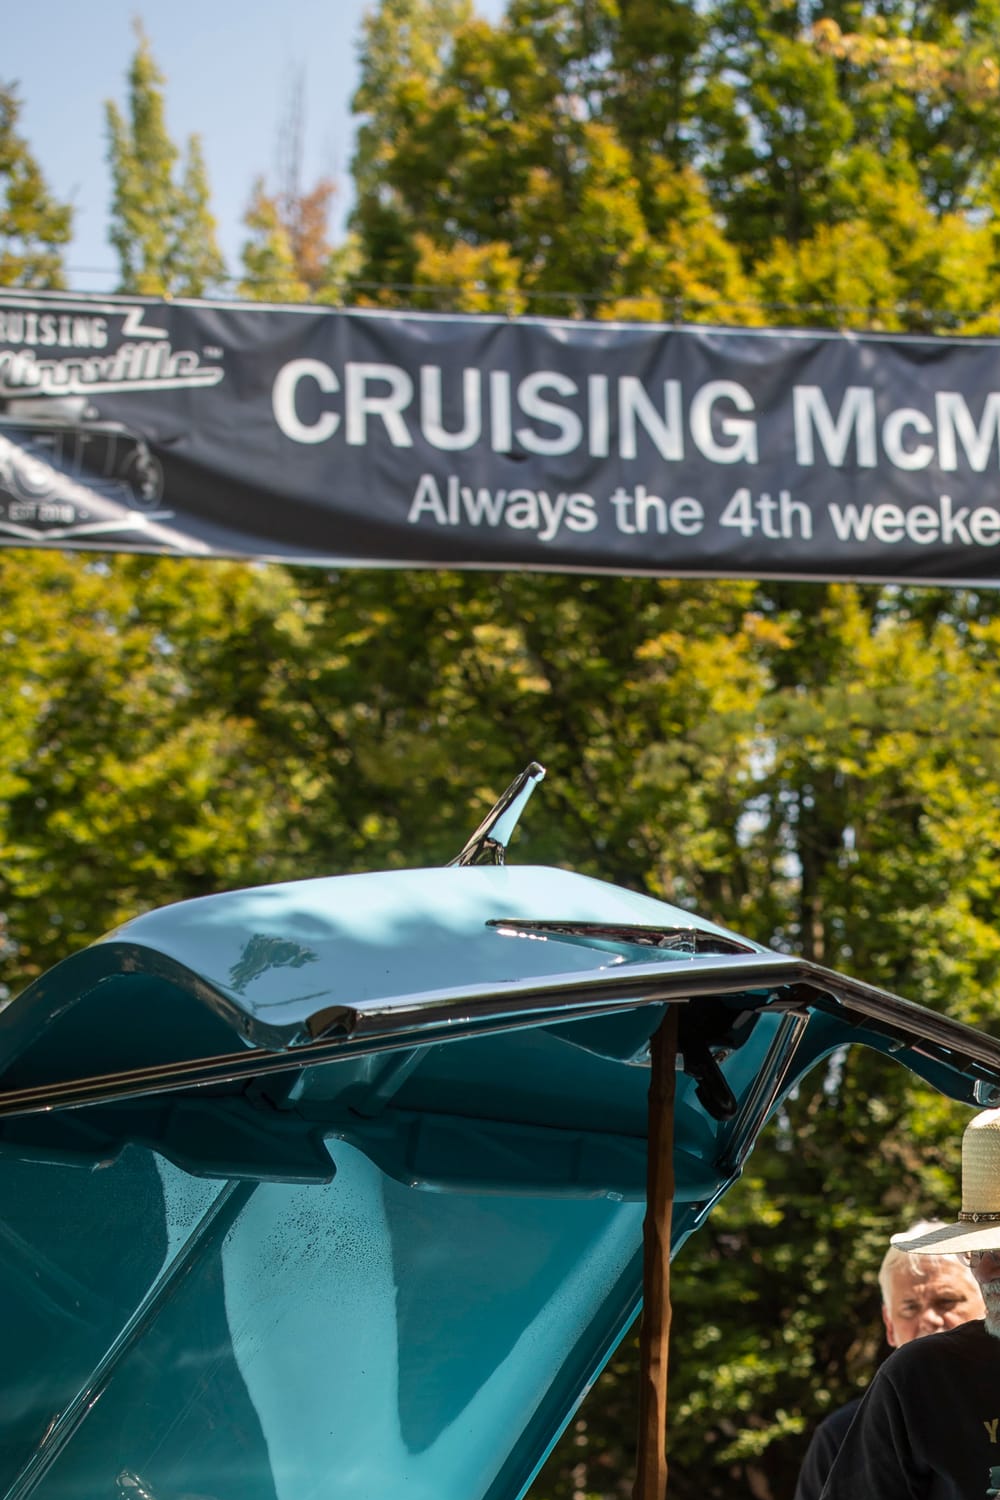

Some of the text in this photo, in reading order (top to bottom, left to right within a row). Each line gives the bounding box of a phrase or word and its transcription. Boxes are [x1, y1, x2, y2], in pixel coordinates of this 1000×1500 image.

[0, 312, 108, 348] RUISING
[272, 358, 758, 465] CRUISING
[407, 473, 598, 542] Always
[610, 484, 704, 536] the
[719, 488, 813, 540] 4th
